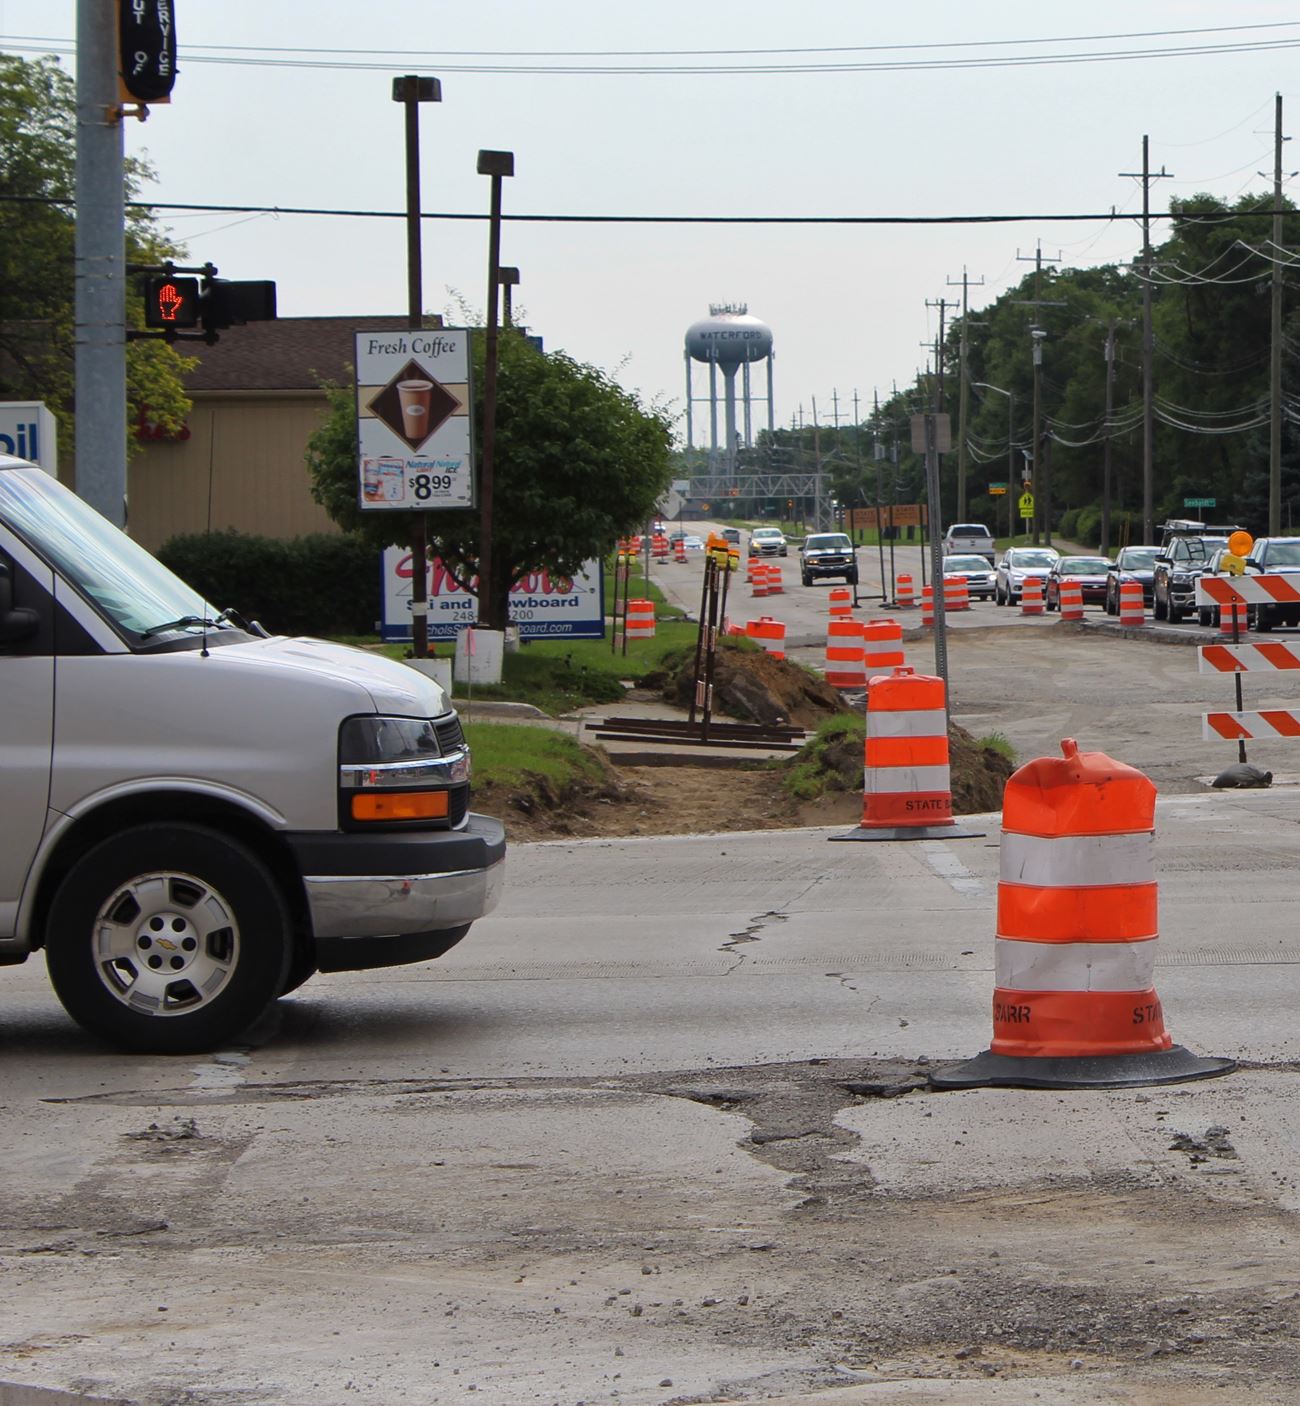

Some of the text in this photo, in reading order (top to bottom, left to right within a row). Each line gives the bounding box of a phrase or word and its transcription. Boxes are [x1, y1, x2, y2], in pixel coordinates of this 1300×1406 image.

[700, 330, 762, 340] WATERFORD
[368, 336, 456, 358] Fresh Coffee
[440, 598, 472, 610] and
[905, 799, 942, 811] STATE
